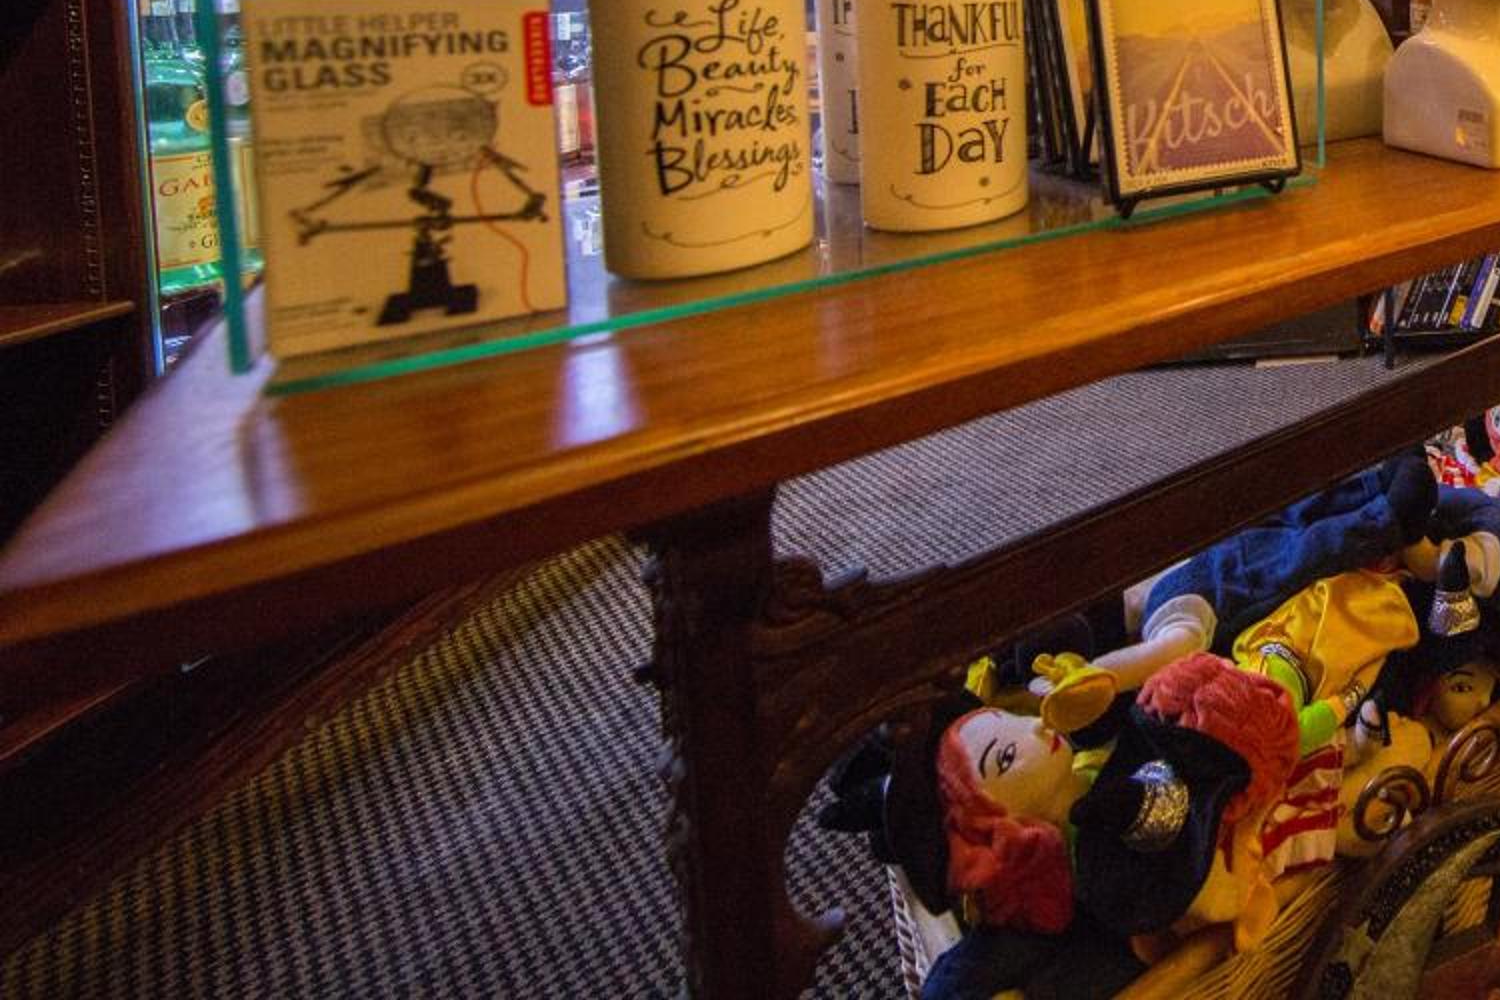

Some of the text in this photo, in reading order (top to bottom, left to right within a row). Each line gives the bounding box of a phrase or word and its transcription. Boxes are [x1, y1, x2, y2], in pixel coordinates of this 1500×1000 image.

[259, 12, 460, 37] LITTLE HELPER
[260, 30, 509, 64] MAGNIFYING
[262, 62, 392, 93] GLASS
[948, 57, 987, 83] for
